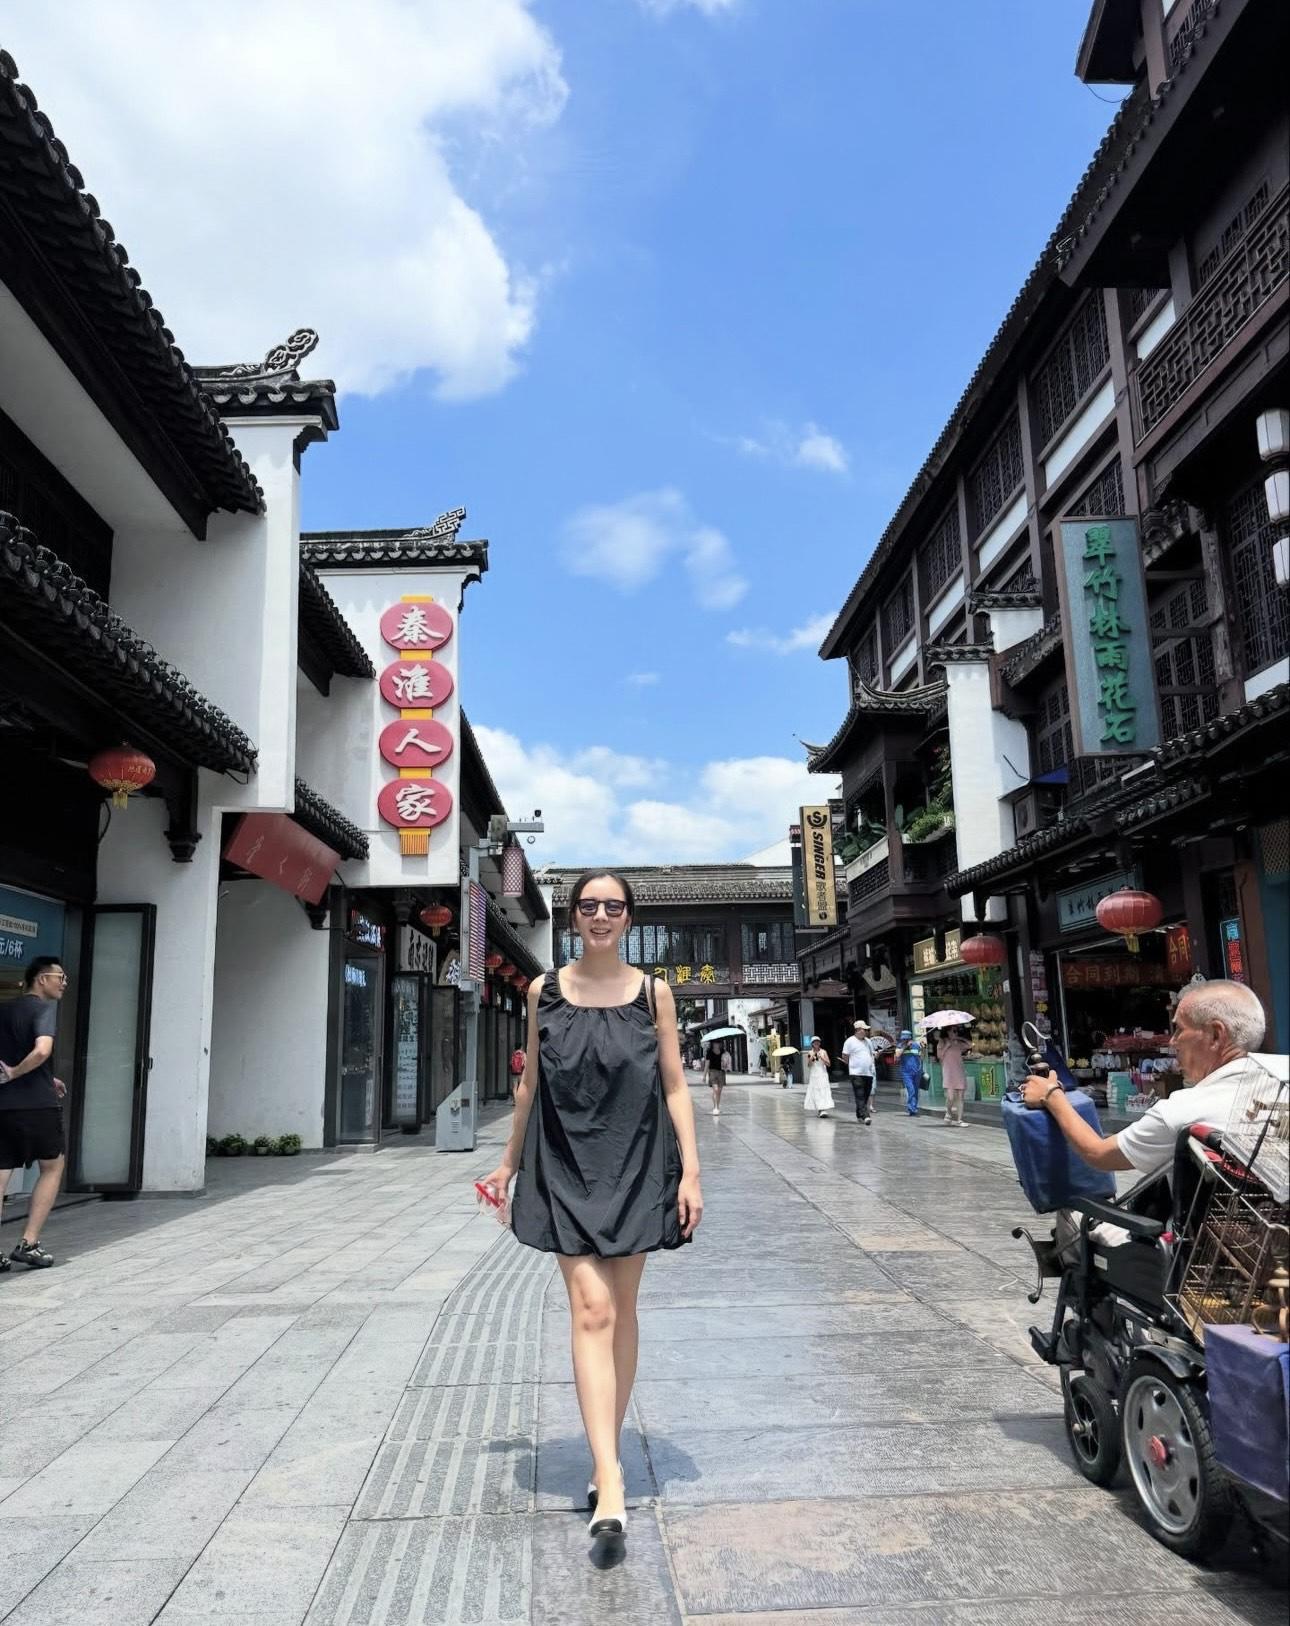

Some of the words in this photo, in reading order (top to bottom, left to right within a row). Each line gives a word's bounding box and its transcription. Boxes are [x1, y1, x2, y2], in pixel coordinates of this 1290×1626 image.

[391, 606, 444, 821] 秦淮人家
[1082, 525, 1137, 743] 翠竹林雨花石
[812, 832, 826, 880] SINGER
